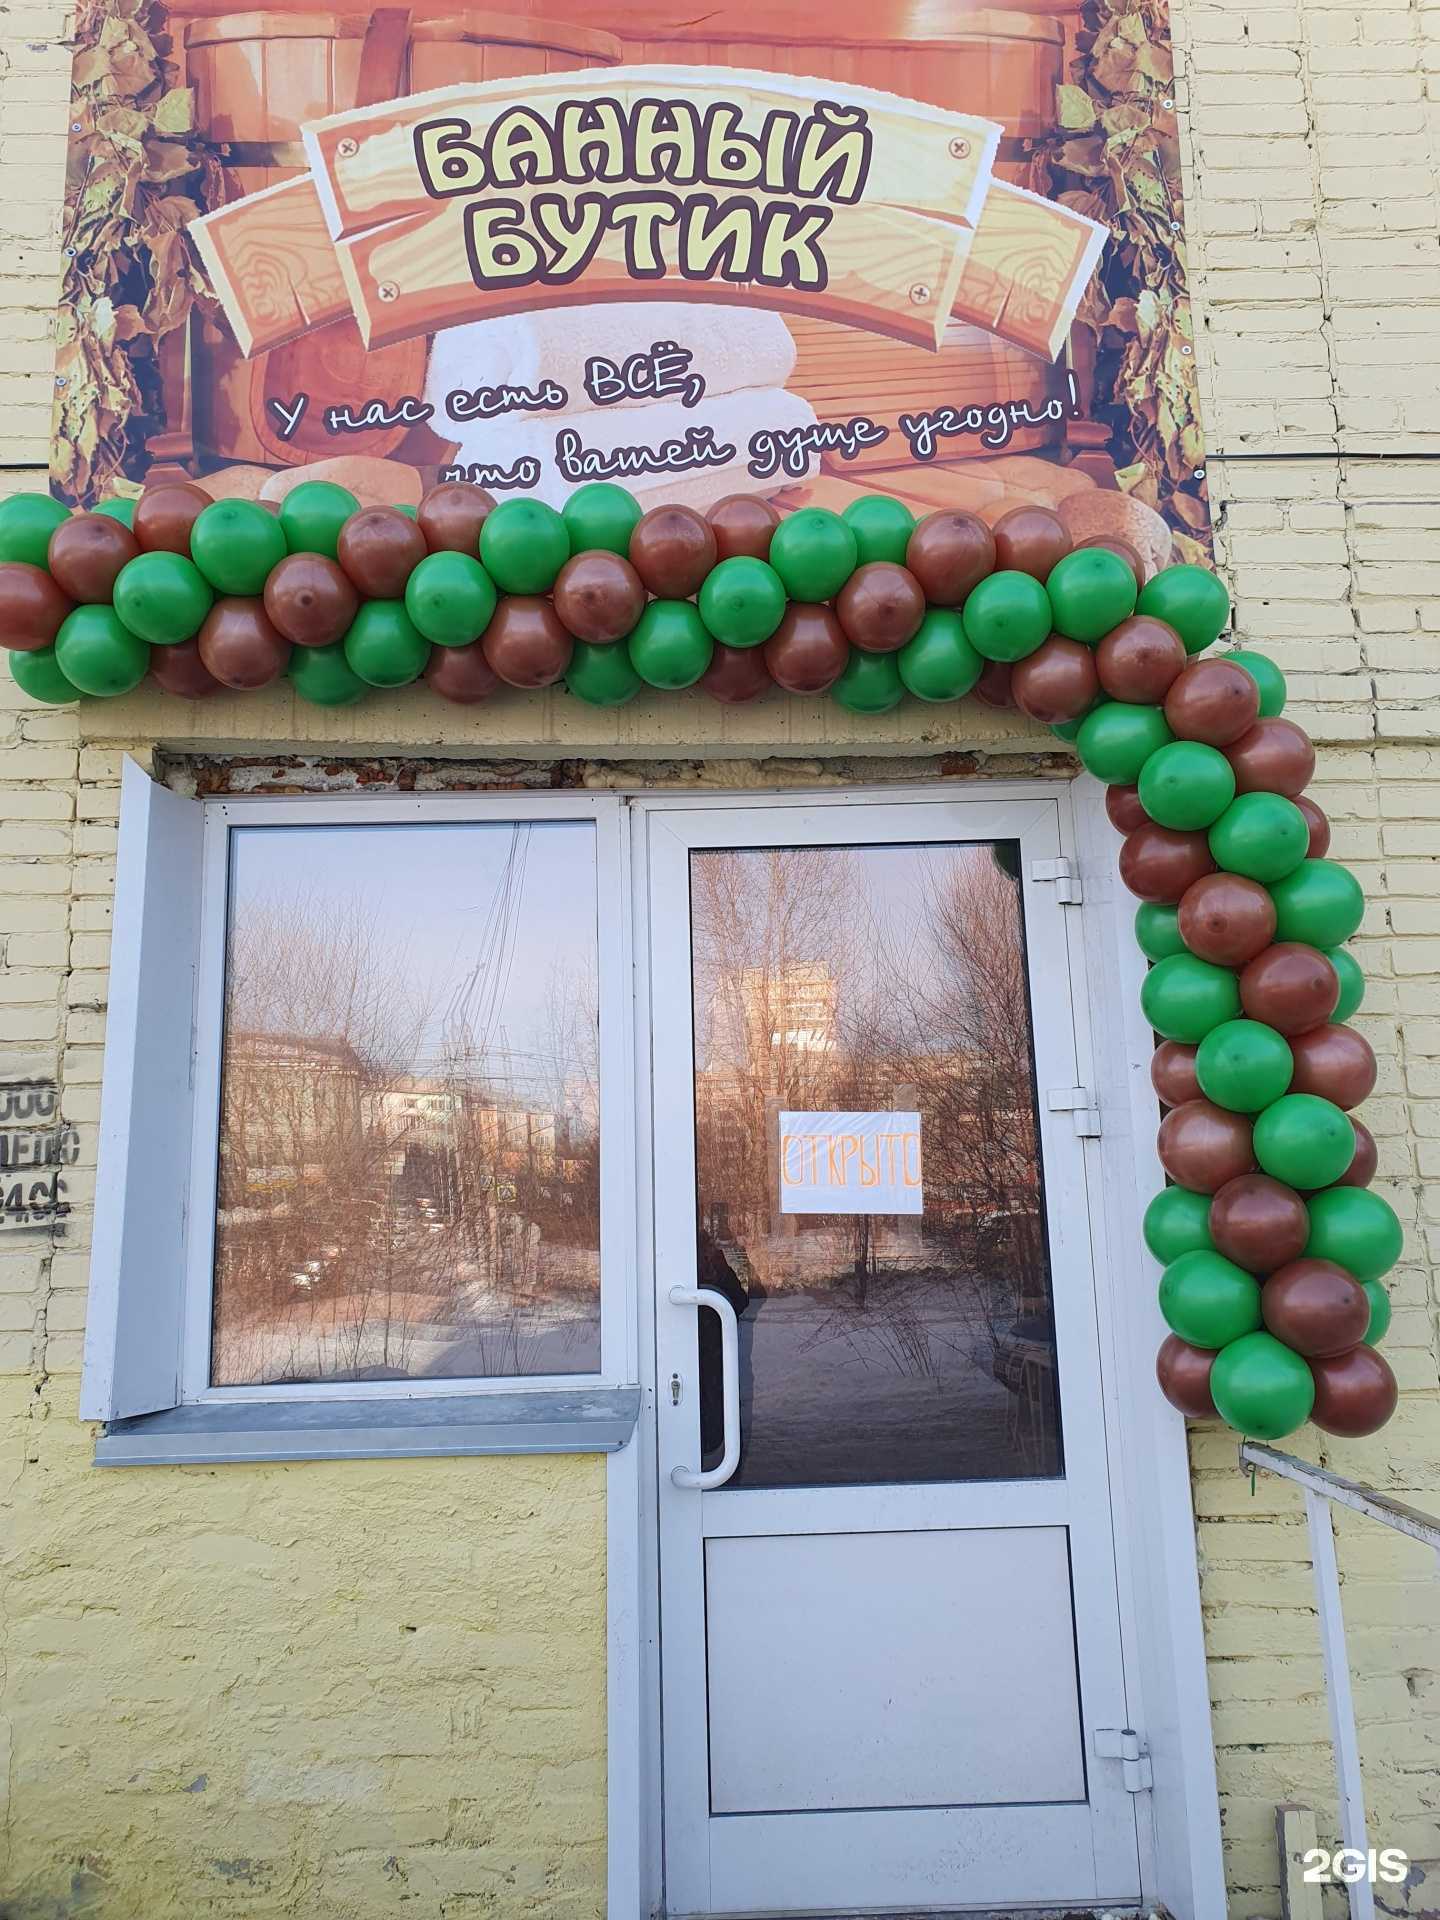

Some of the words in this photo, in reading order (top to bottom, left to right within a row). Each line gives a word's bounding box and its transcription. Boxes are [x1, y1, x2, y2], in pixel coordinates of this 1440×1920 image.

[415, 98, 872, 204] БАННЫЙ
[464, 191, 833, 291] БУТИК
[270, 394, 308, 438] У
[328, 397, 432, 432] нас
[449, 384, 566, 418] есть
[588, 342, 703, 404] ВСЁ,
[559, 429, 734, 479] вашей
[903, 371, 1082, 458] угодно!
[782, 1132, 922, 1187] ОТКРЫТО
